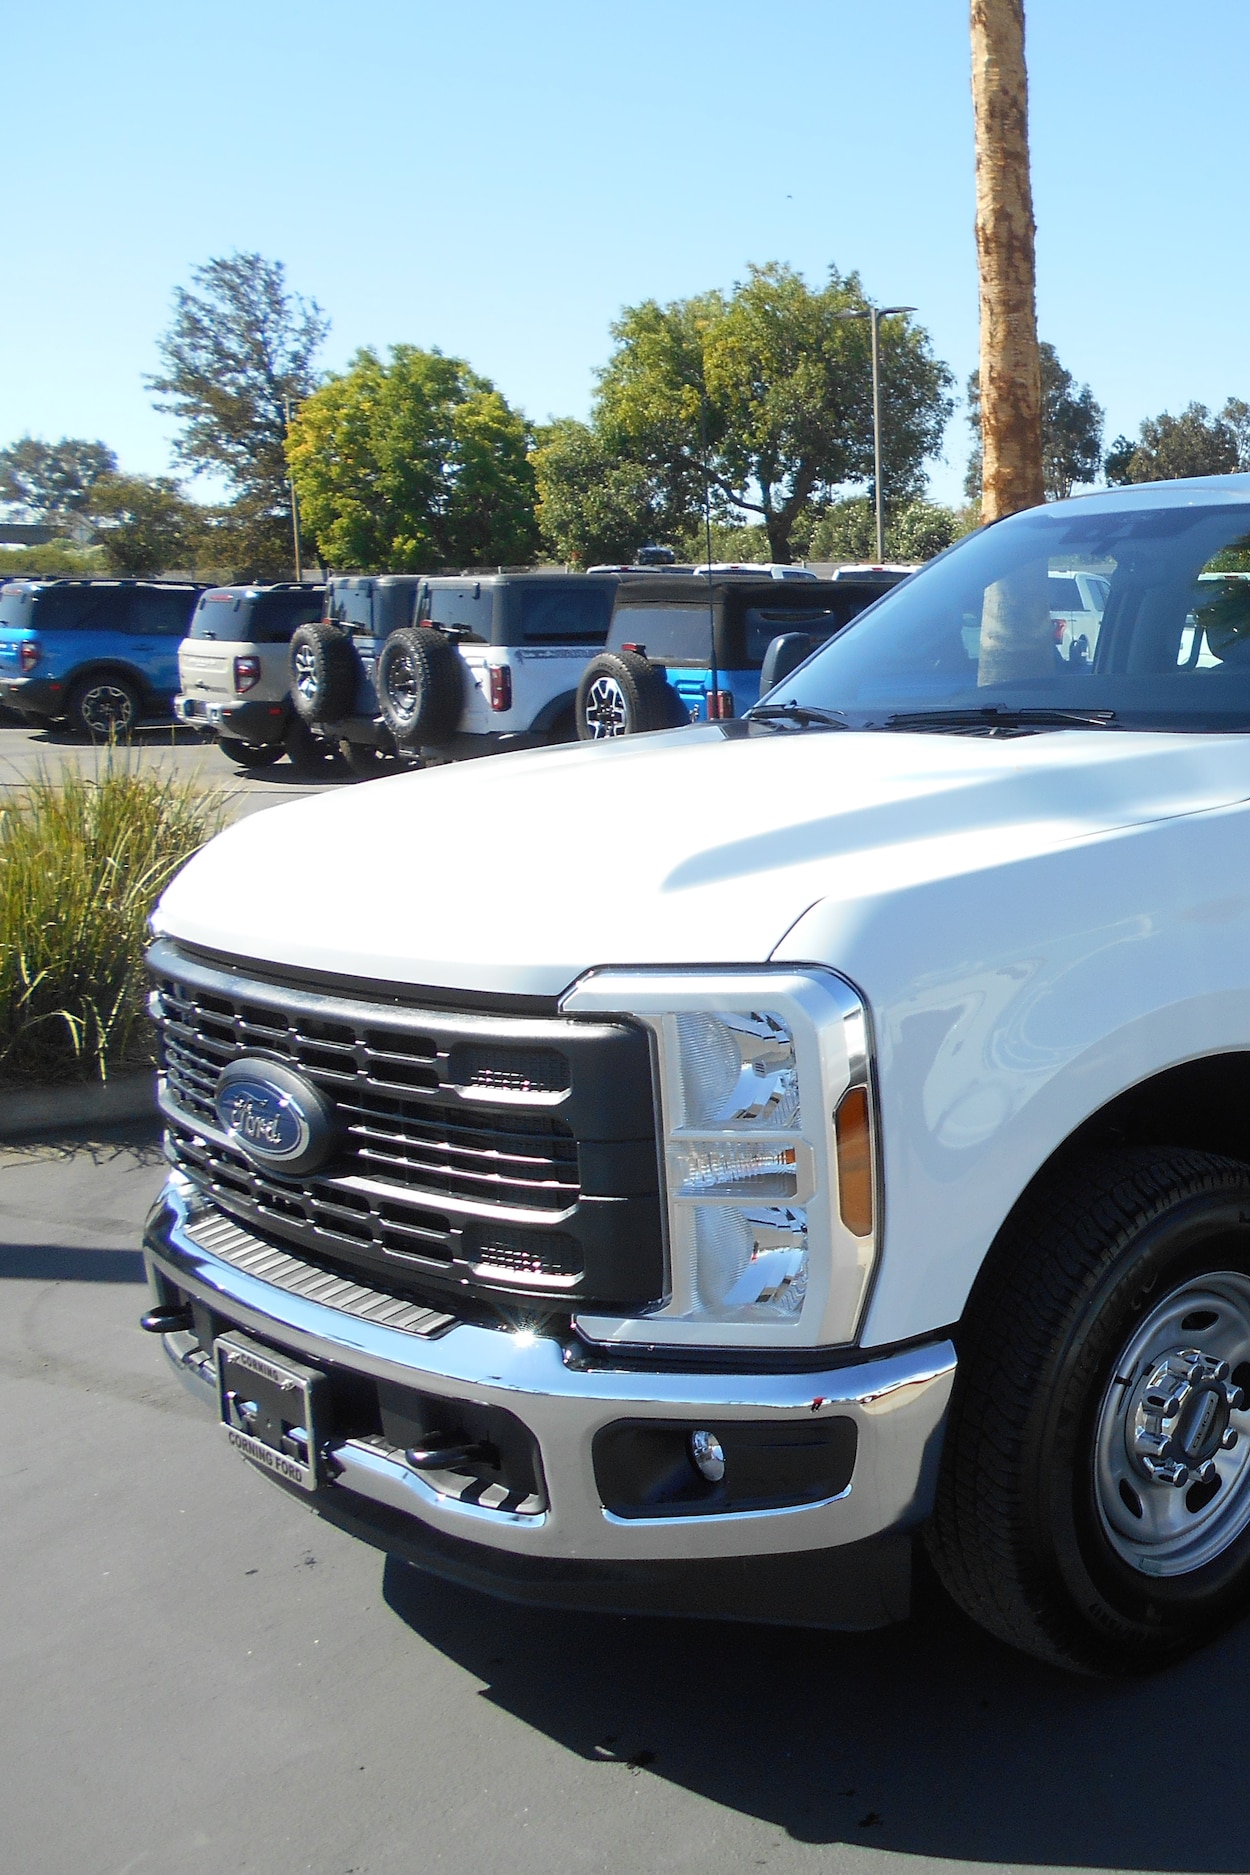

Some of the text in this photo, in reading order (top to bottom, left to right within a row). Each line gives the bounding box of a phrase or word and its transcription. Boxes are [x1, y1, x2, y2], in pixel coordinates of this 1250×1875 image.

[226, 1090, 282, 1144] Ford
[240, 1352, 279, 1381] CORNING
[228, 1431, 302, 1483] CORNING FORD
